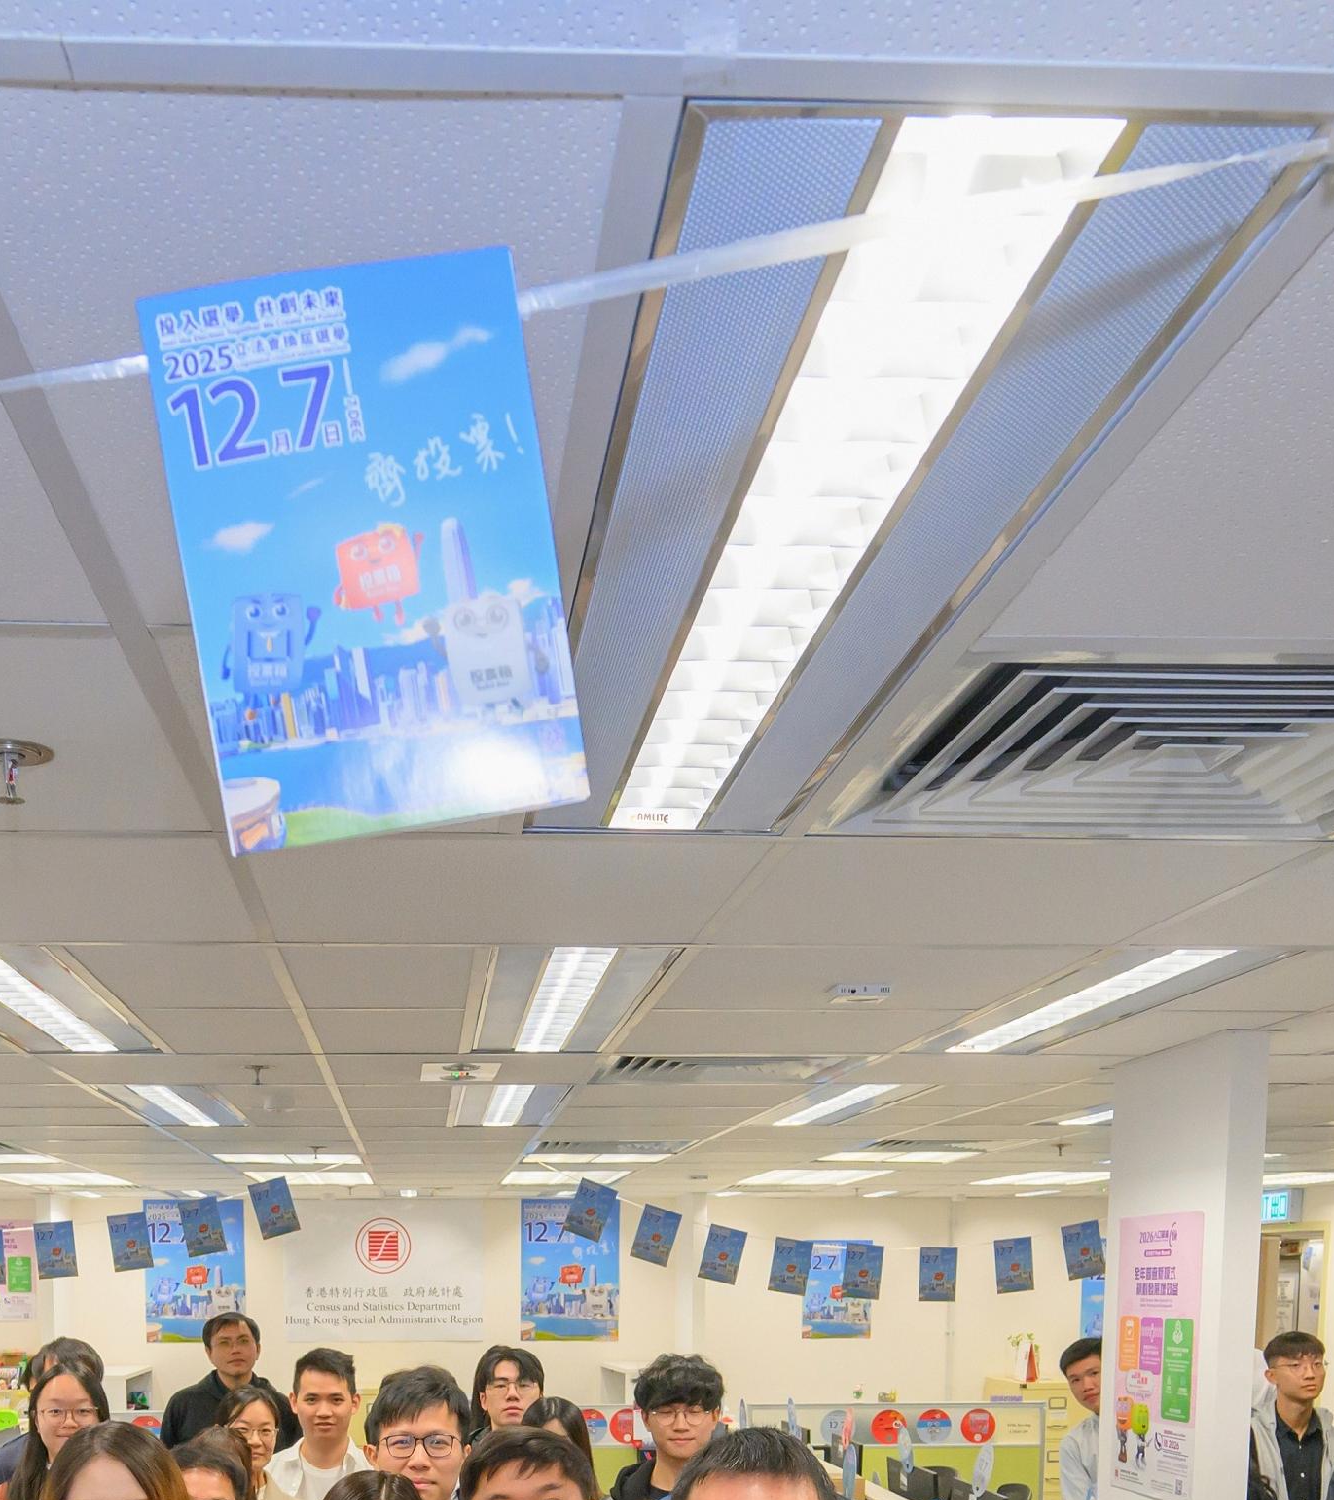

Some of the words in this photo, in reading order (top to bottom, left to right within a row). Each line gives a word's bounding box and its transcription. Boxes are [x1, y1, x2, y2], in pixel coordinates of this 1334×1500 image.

[160, 306, 241, 336] 投入選舉
[258, 289, 340, 317] 共創未來
[1270, 1193, 1288, 1219] 出口
[304, 1285, 389, 1299] 香港特別行政區
[402, 1285, 465, 1299] 政府統計處
[306, 1302, 341, 1313] Census
[342, 1302, 360, 1313] and
[362, 1302, 405, 1313] Statistics
[406, 1302, 461, 1315] Department
[285, 1314, 312, 1328] Hong
[313, 1314, 341, 1328] Kong
[342, 1314, 377, 1328] Special
[378, 1314, 448, 1326] Administrative
[449, 1314, 484, 1328] Region
